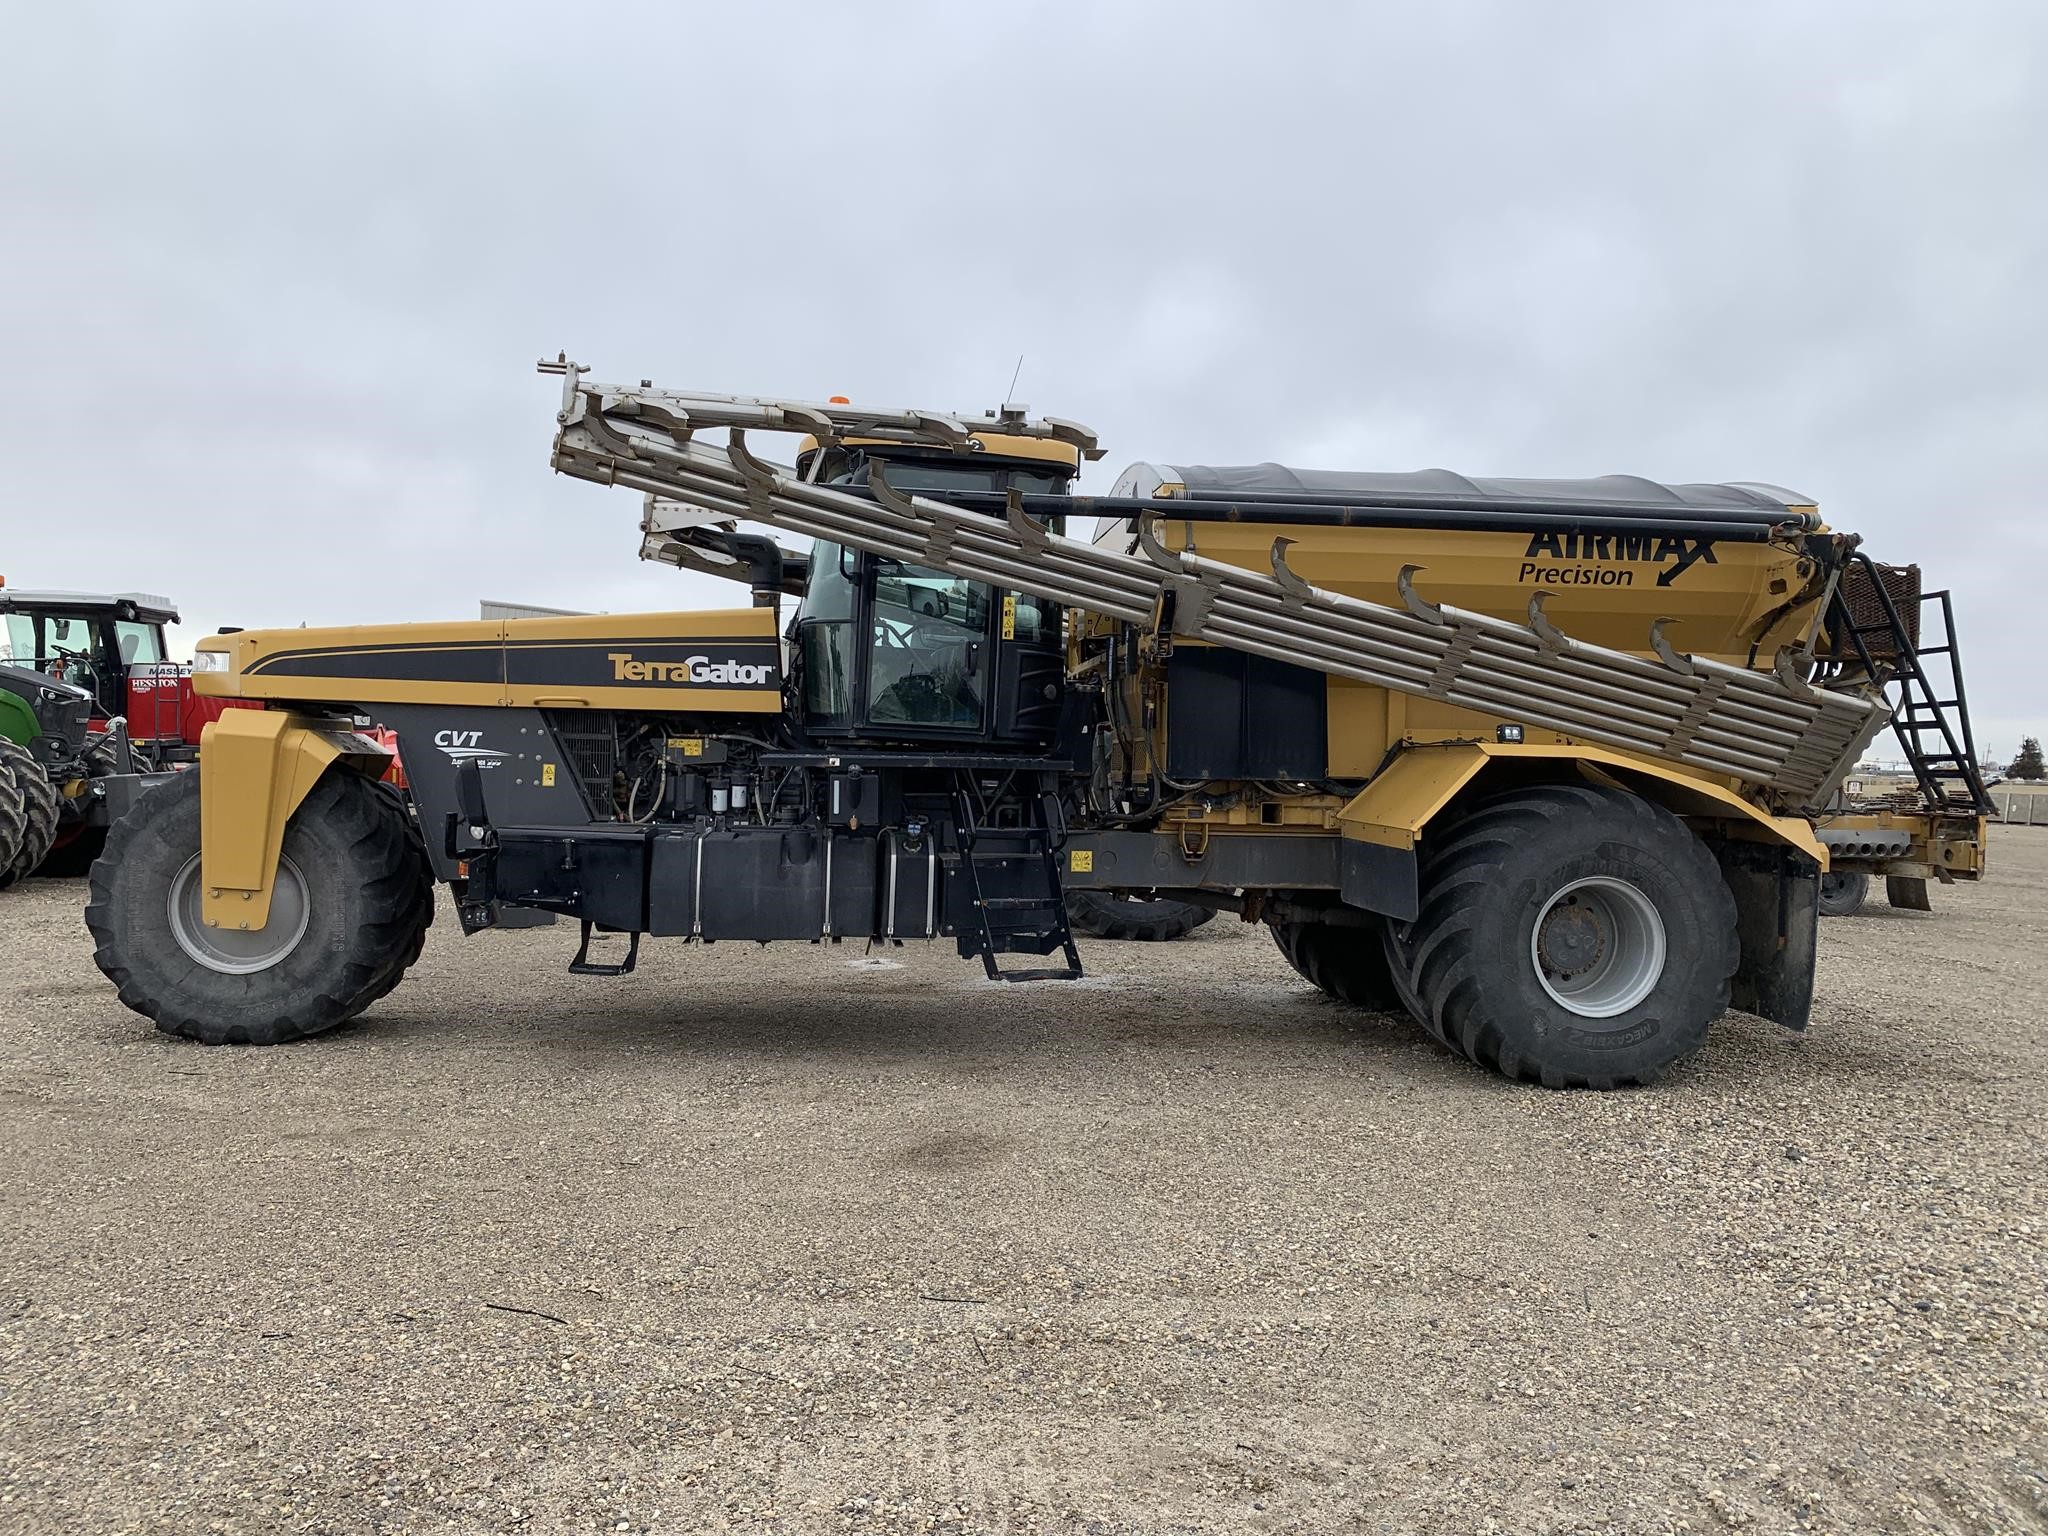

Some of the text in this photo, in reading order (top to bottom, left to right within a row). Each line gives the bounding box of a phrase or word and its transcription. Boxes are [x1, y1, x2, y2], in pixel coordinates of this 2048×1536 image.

[1525, 532, 1718, 564] AIRMAX
[1519, 562, 1634, 586] Precision
[608, 653, 773, 684] TerraGator
[132, 679, 178, 687] HESSTON
[434, 730, 483, 747] CVT
